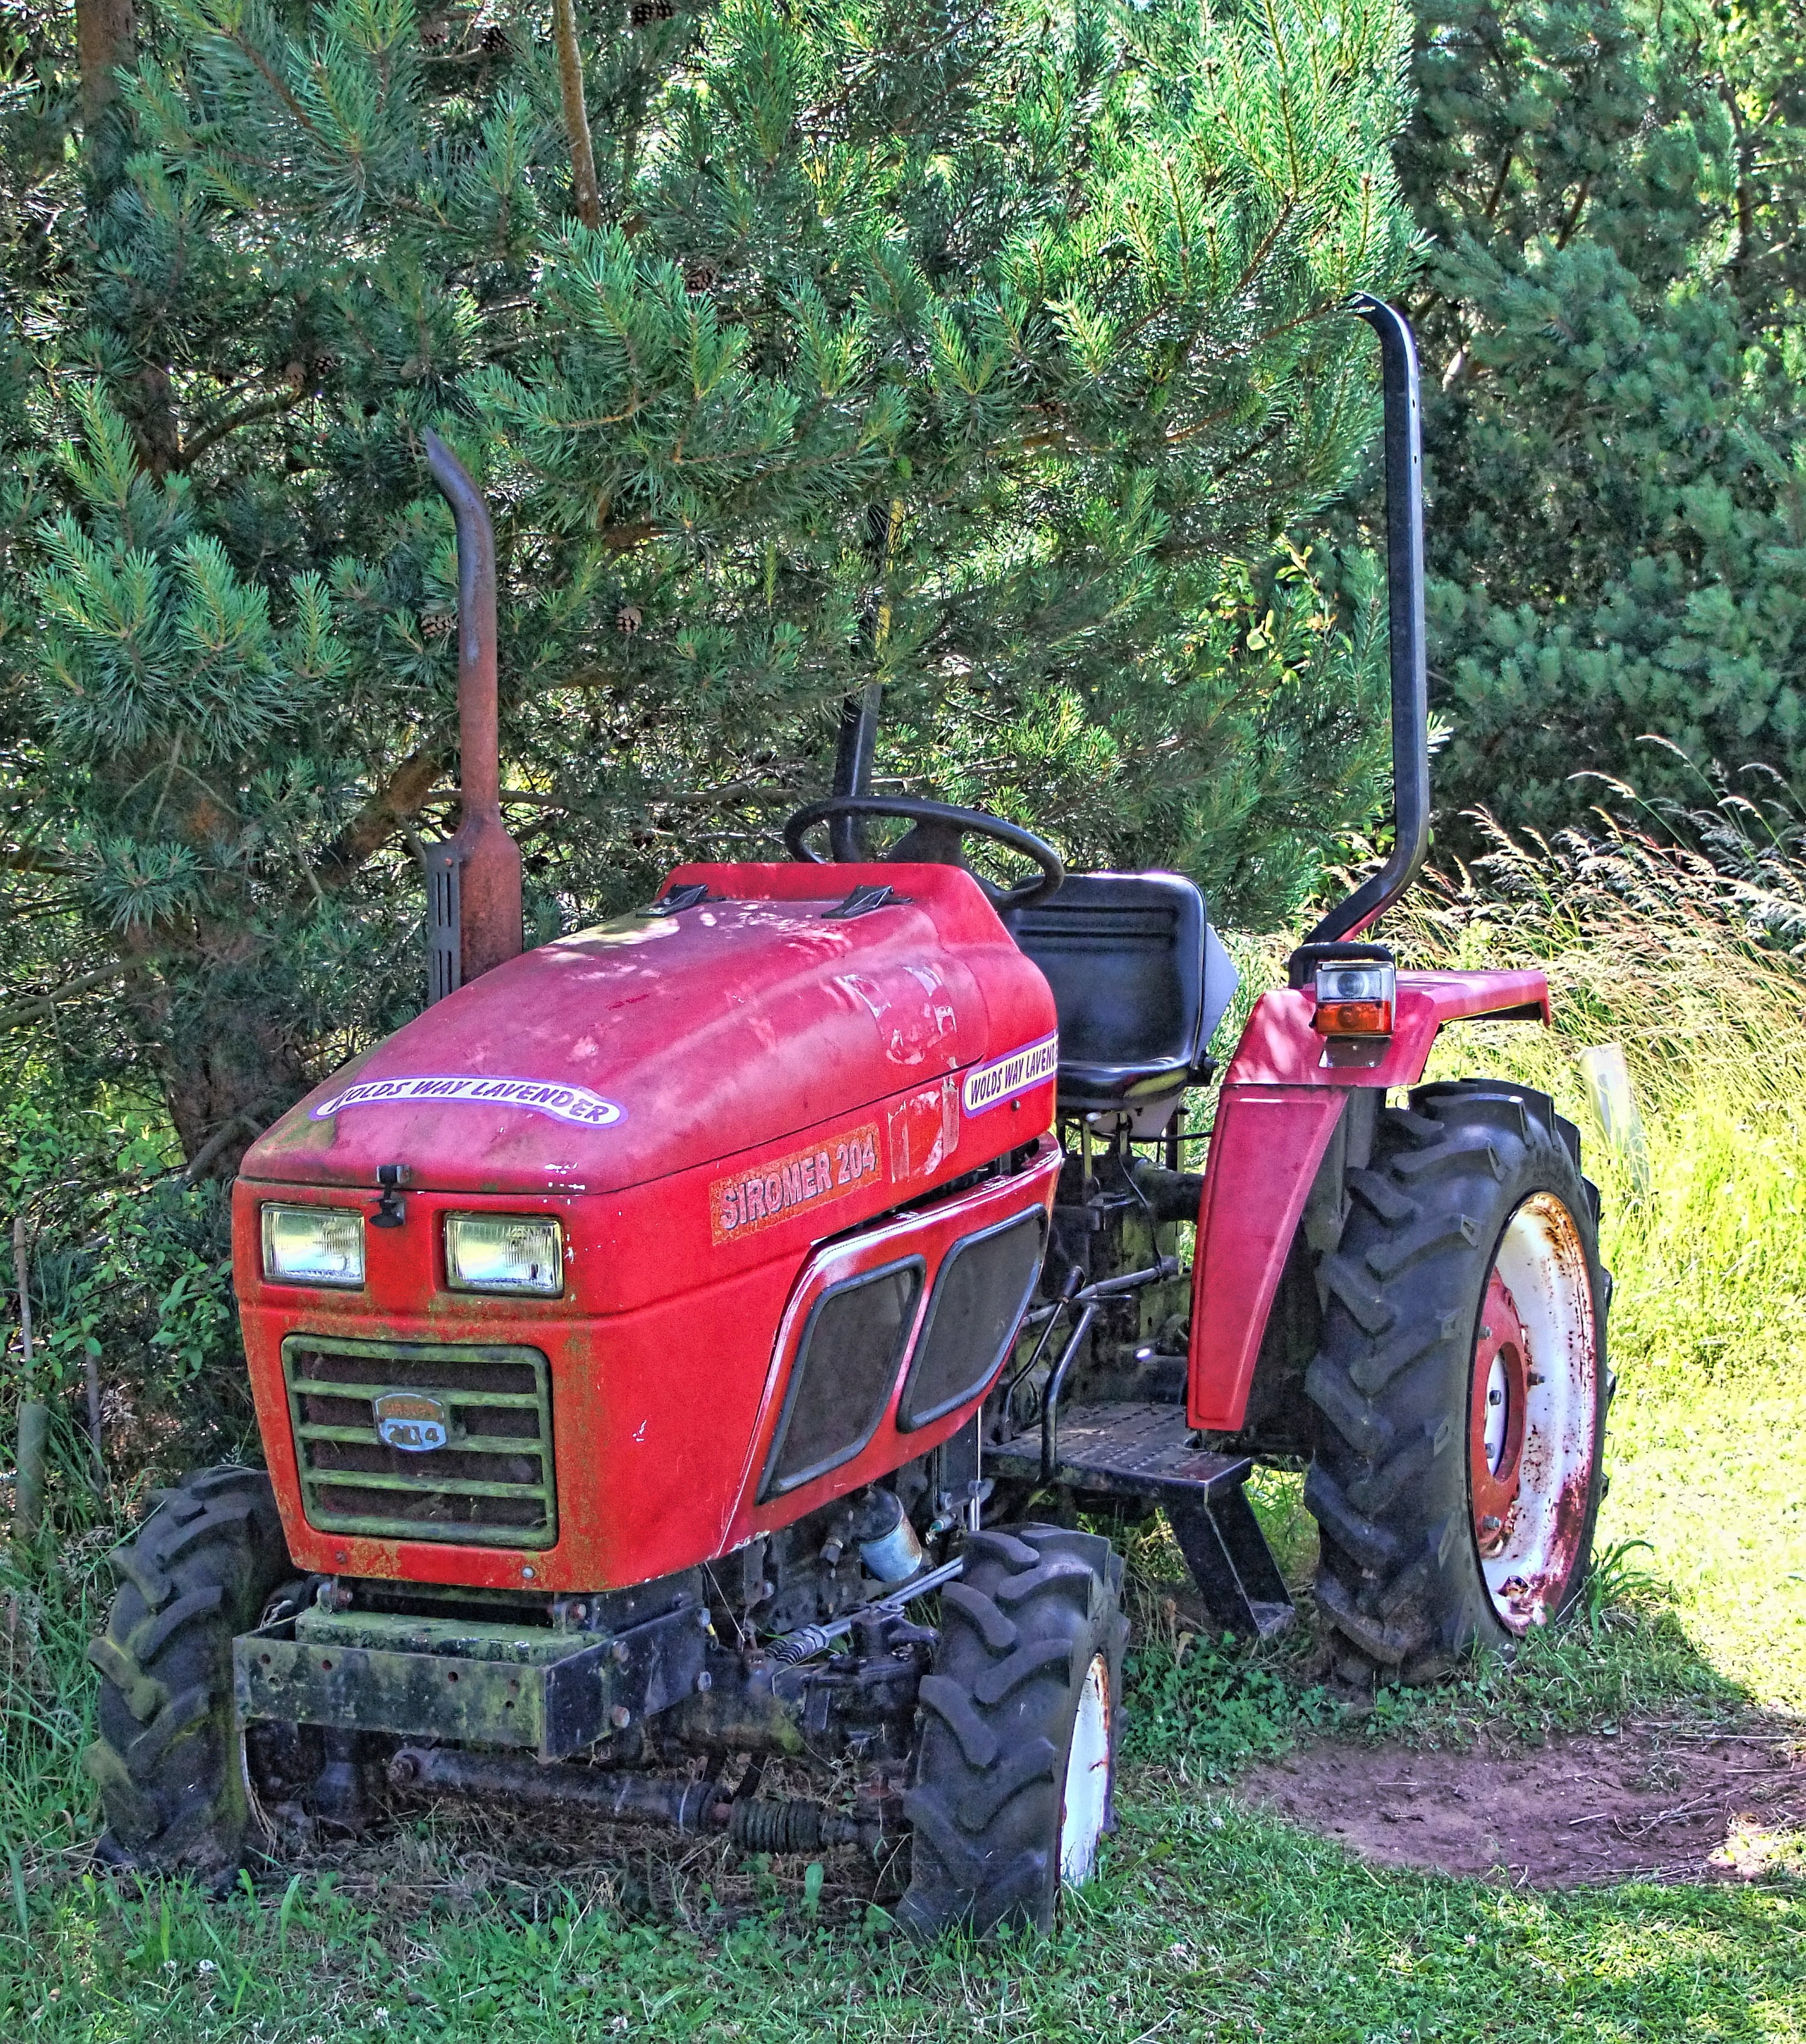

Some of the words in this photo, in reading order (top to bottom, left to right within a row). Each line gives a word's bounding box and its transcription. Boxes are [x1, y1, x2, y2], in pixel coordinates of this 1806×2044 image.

[410, 1081, 473, 1095] WAY
[471, 1082, 609, 1122] LAVENDER
[970, 1067, 1002, 1105] WOLDS
[1004, 1058, 1024, 1089] WAY
[720, 1151, 833, 1230] SIROMER
[836, 1133, 876, 1185] 204
